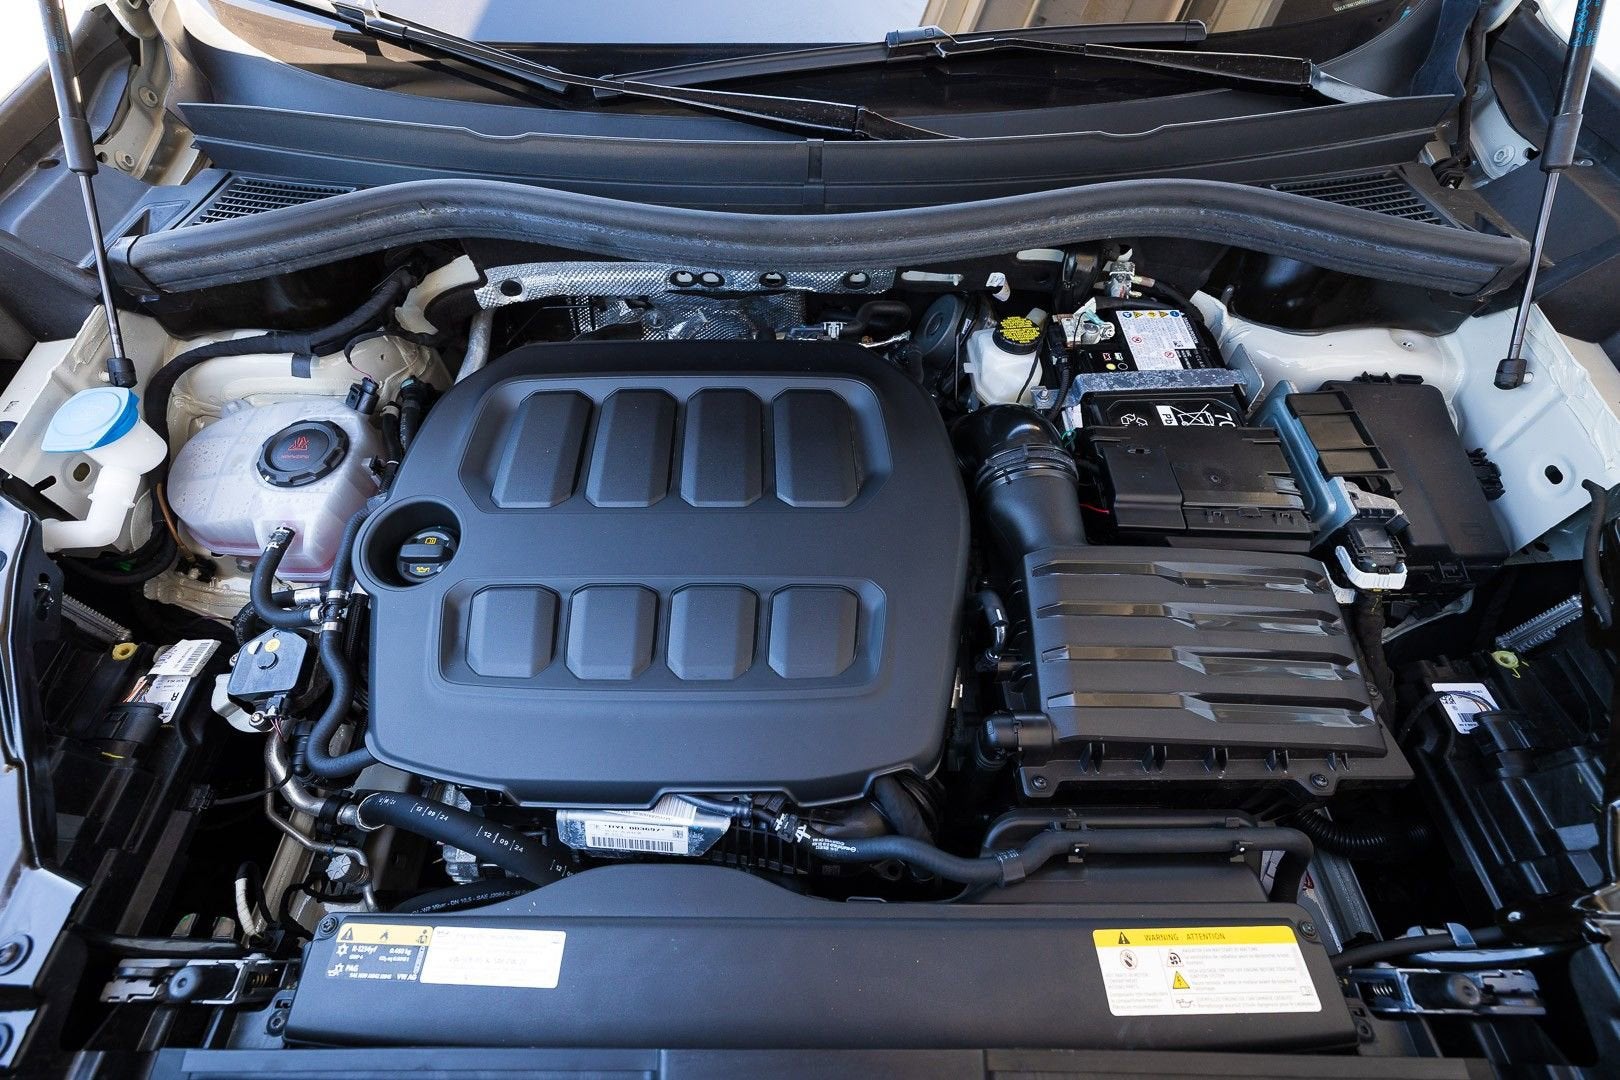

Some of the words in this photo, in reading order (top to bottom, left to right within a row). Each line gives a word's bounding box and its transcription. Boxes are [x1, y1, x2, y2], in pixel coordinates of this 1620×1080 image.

[1162, 413, 1173, 425] Pb
[1144, 933, 1179, 942] WARNING
[1186, 932, 1226, 941] ATTENTION
[345, 964, 359, 972] PAG
